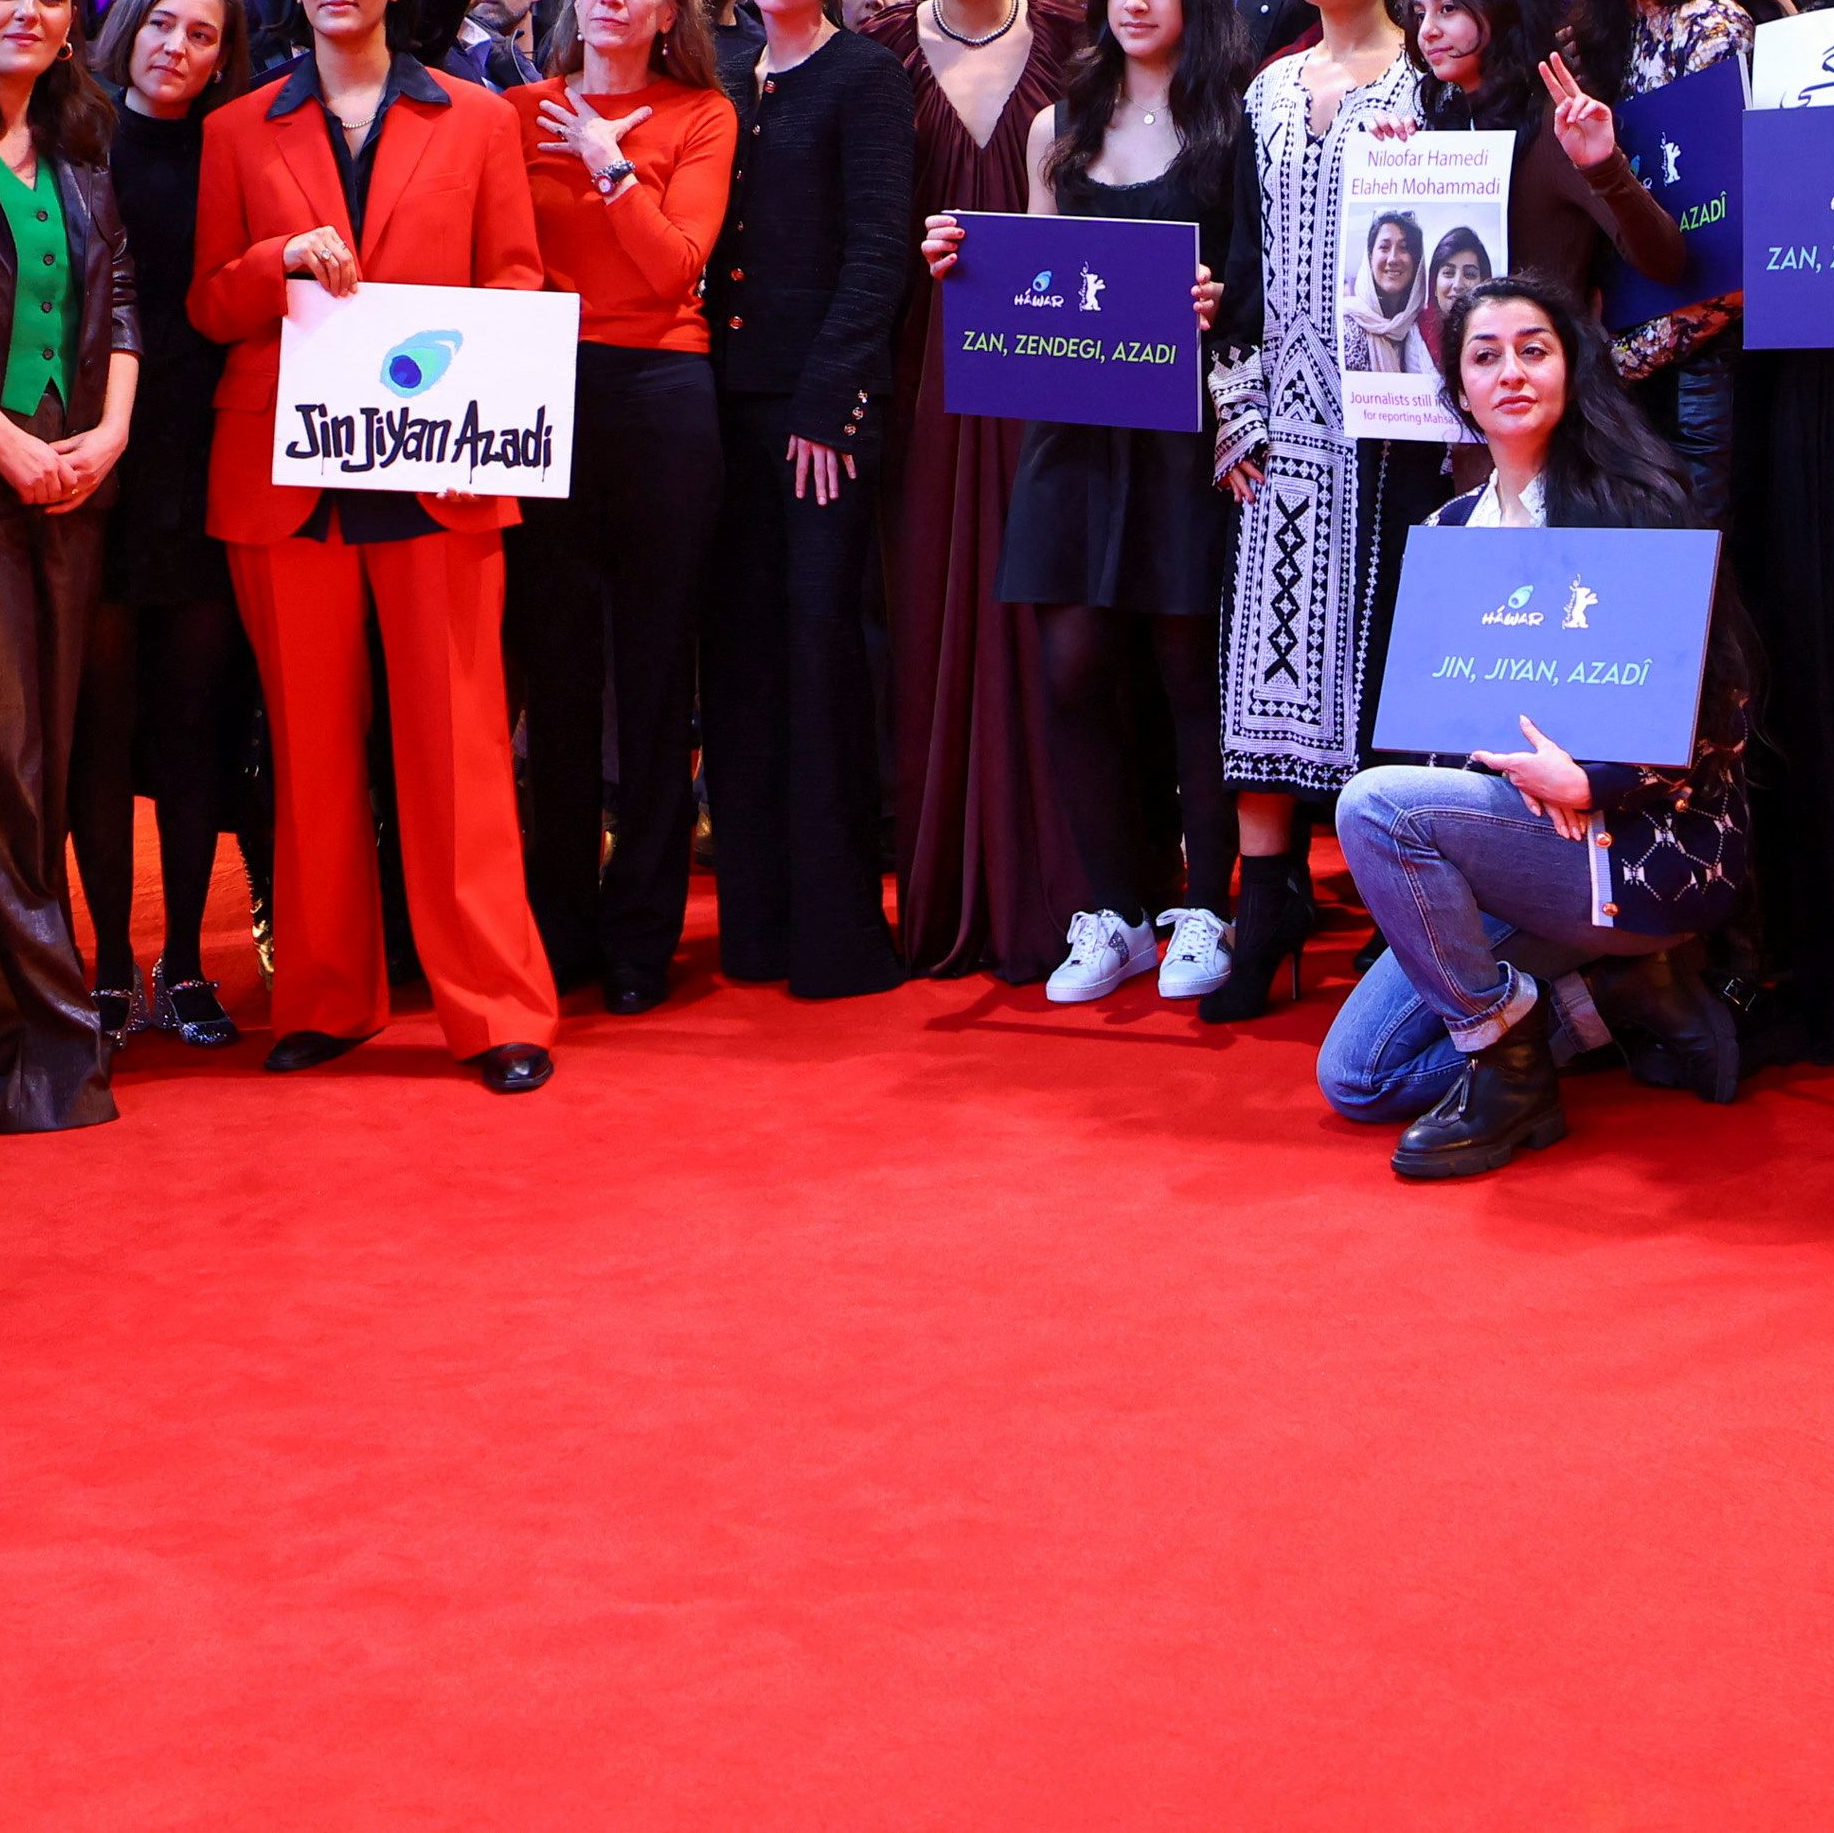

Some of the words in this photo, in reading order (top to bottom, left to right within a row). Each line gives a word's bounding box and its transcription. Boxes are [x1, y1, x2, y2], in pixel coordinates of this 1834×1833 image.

[1368, 148, 1423, 167] Niloofar
[1427, 149, 1489, 167] Hamedi
[1351, 177, 1398, 195] Elaheh
[1402, 177, 1501, 195] Mohammadi
[1679, 190, 1727, 233] AZADÎ
[1766, 245, 1822, 273] ZAN,
[962, 331, 1009, 357] ZAN,
[1014, 334, 1106, 364] ZENDEGI,
[1111, 341, 1177, 365] AZADI
[1350, 391, 1410, 407] Journalists
[1412, 394, 1432, 407] still
[1379, 412, 1422, 425] reporting
[285, 402, 355, 460] Jin
[451, 400, 553, 470] Azadi
[1432, 656, 1477, 683] JIN,
[1484, 658, 1559, 687] JIYAN,
[1566, 658, 1654, 687] AZADÎ
